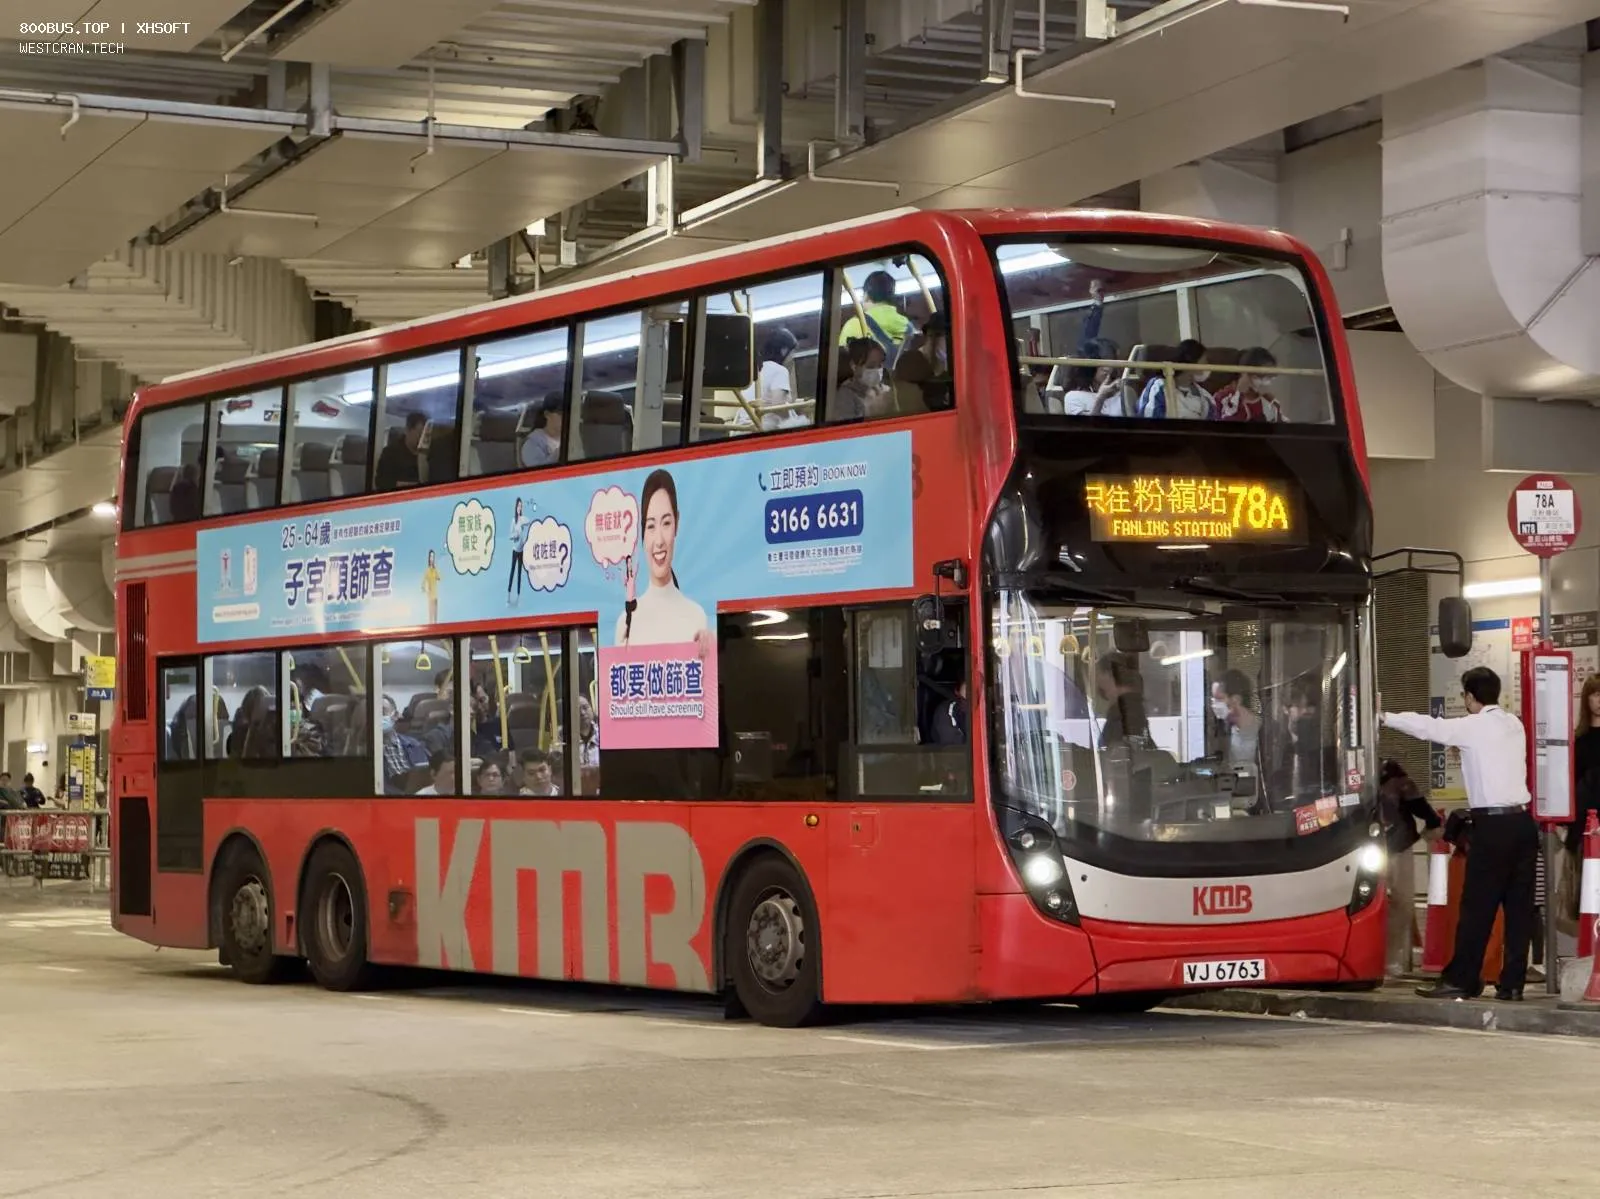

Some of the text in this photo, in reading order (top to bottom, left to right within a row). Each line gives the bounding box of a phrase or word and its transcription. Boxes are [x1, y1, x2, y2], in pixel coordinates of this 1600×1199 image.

[770, 464, 867, 491] 立即預約 BOOK NOW
[1228, 486, 1289, 530] 78A
[1535, 494, 1555, 508] 78A
[770, 501, 857, 534] 3166 6631
[1113, 520, 1232, 537] FANLING STATION
[610, 661, 702, 697] 都要做篩查
[610, 702, 703, 716] Should still have screening
[1192, 884, 1253, 916] KMB
[1187, 961, 1260, 982] VJ 6763
